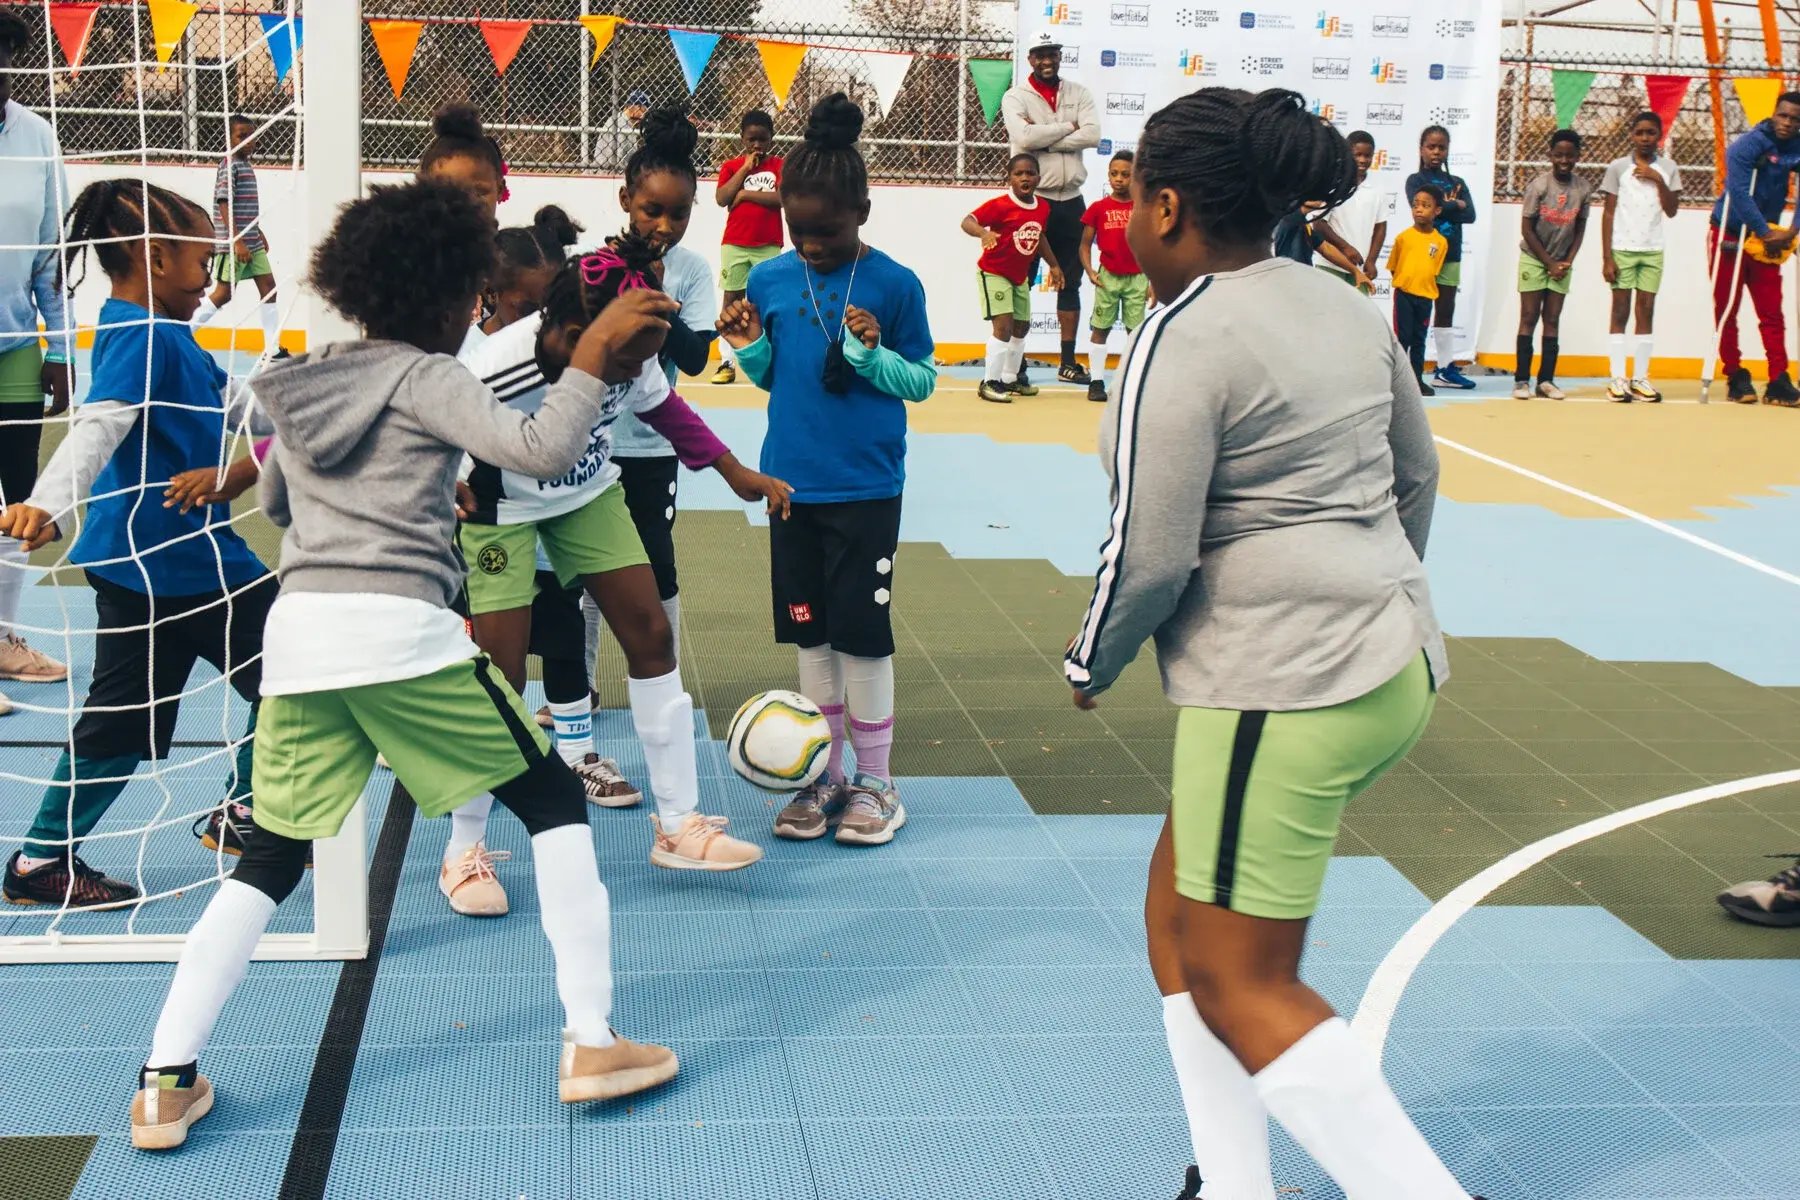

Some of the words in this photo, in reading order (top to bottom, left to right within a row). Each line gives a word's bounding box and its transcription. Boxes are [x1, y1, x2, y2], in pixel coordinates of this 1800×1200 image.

[746, 176, 776, 190] THING
[793, 605, 807, 614] UNI
[796, 612, 810, 622] QLO
